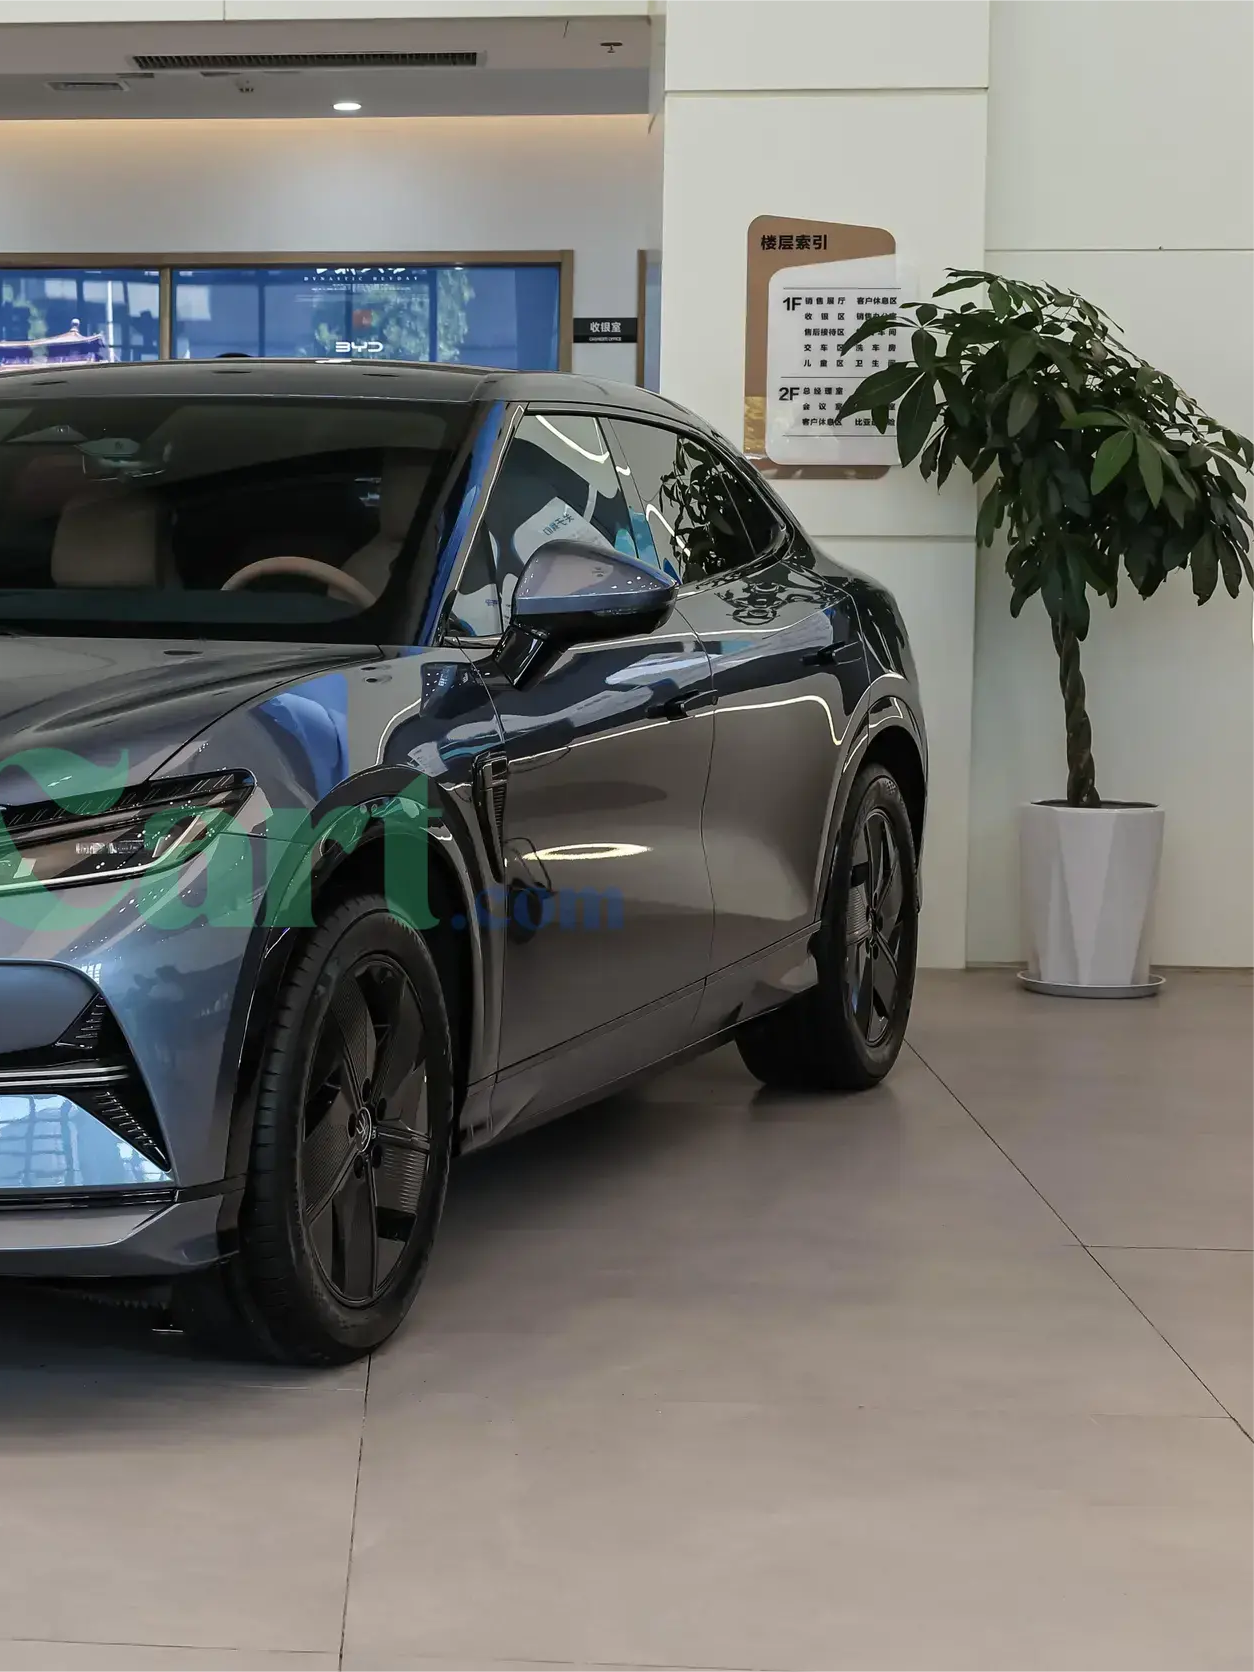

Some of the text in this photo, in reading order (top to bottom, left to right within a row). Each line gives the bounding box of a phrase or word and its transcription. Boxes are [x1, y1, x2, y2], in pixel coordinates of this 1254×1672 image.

[760, 234, 828, 251] 楼层索引
[783, 296, 802, 311] 1F
[805, 297, 846, 305] 销售展厅
[856, 296, 897, 305] 客户休息区
[804, 312, 845, 321] 收银区
[590, 321, 622, 333] 收银室
[804, 328, 845, 337] 售后接待区
[335, 341, 384, 353] BYD
[803, 344, 843, 352] 交车区
[855, 344, 896, 352] 洗车房
[803, 359, 844, 368] 儿童区
[778, 387, 800, 401] 2F
[802, 387, 843, 395] 总经理室
[802, 403, 843, 411] 会议室
[802, 418, 843, 427] 客户休息区
